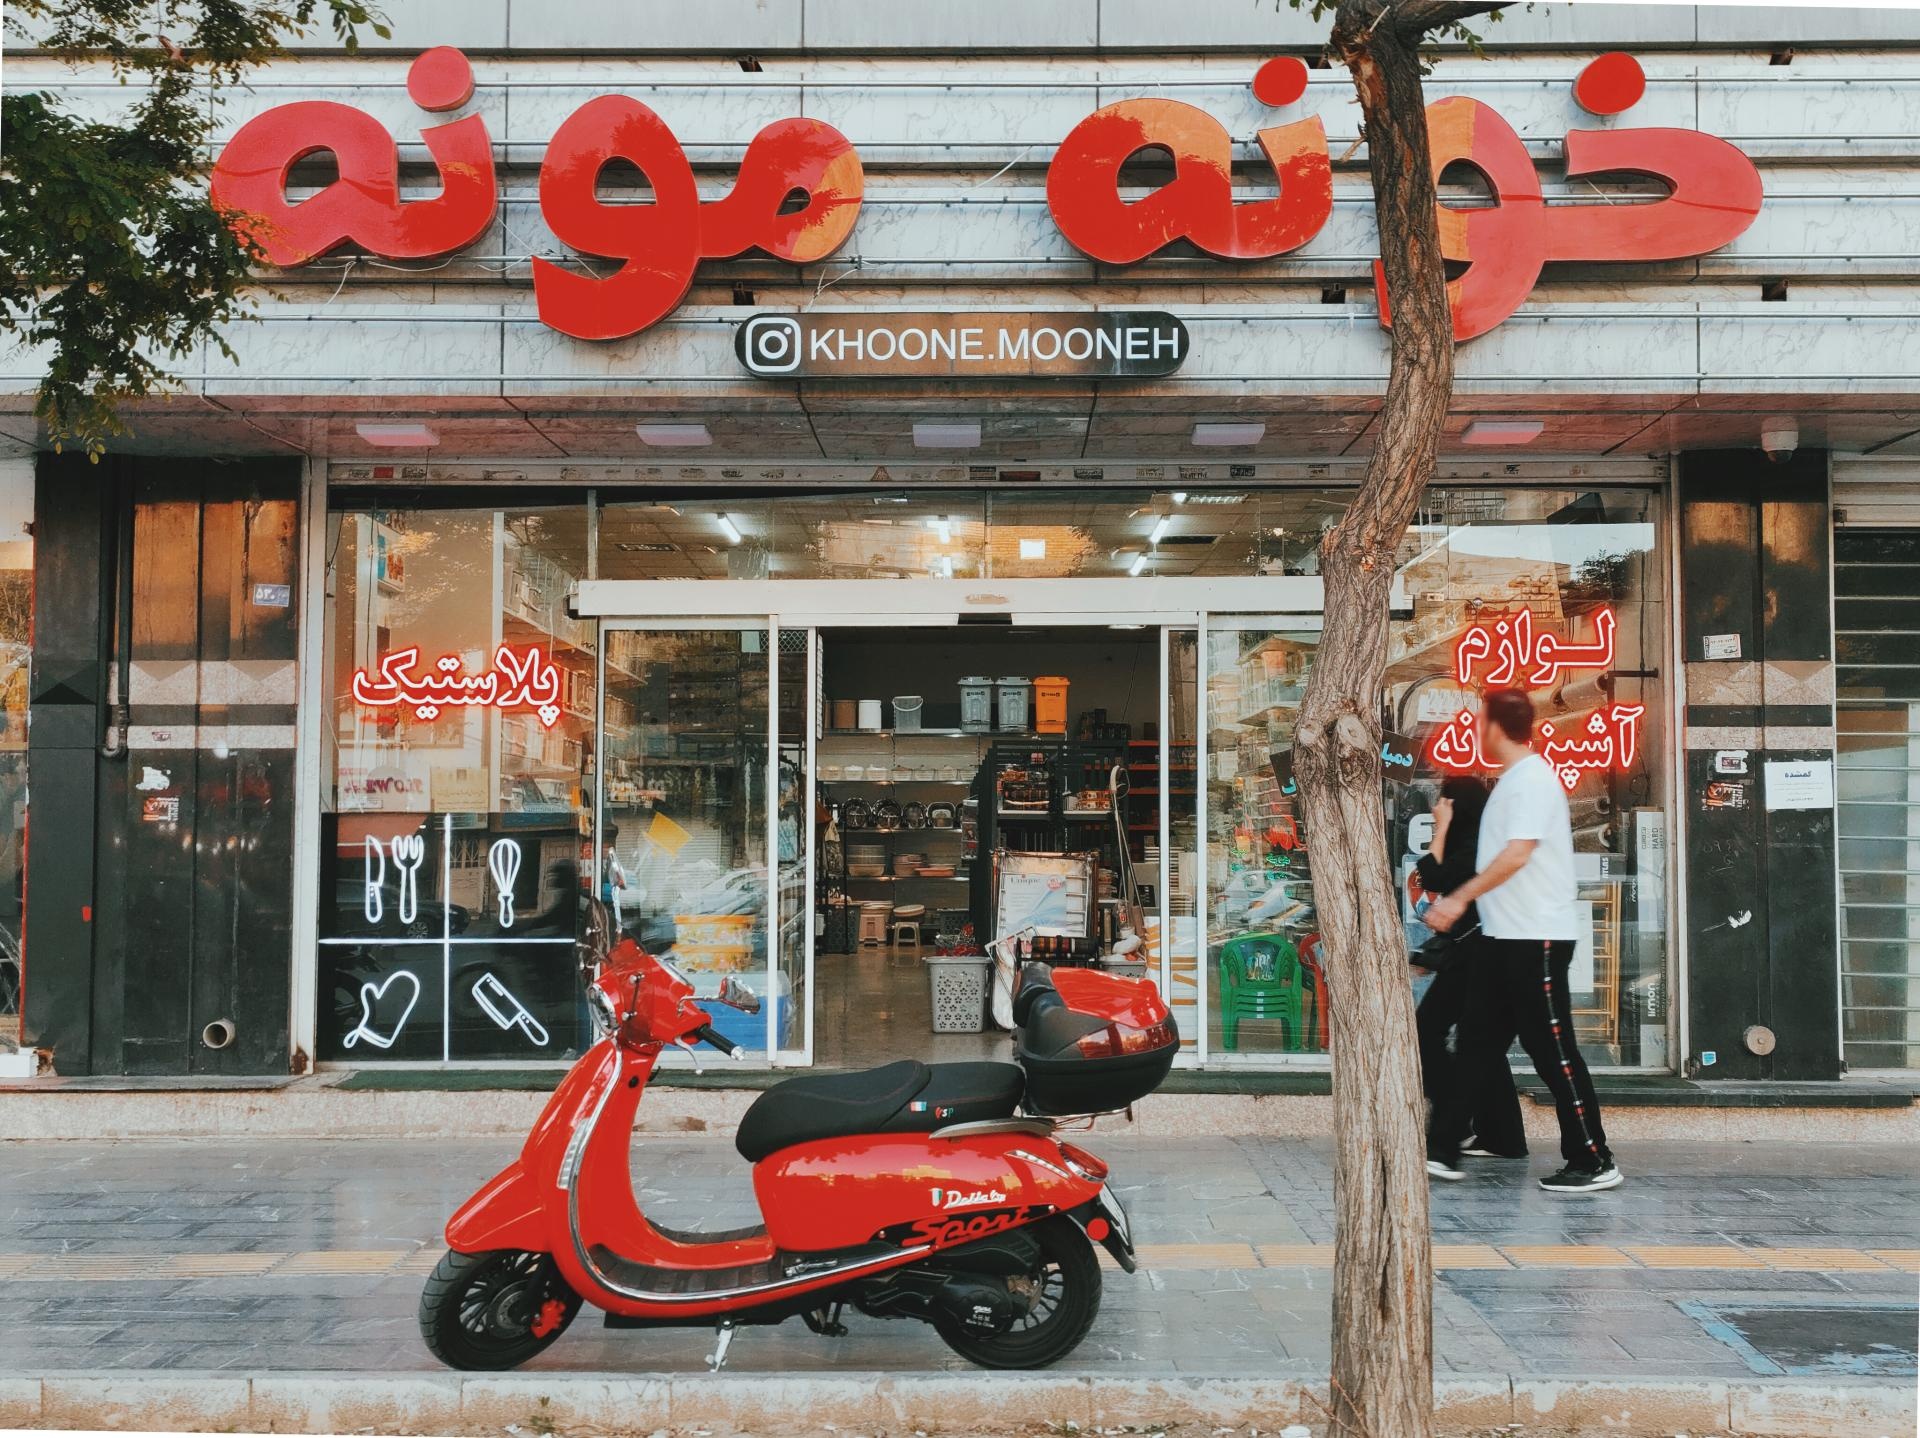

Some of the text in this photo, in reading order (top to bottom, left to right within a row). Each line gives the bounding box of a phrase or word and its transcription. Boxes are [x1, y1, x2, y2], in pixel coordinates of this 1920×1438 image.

[211, 46, 865, 341] مونه
[810, 327, 1180, 361] KHOONE.MOONEH
[1458, 608, 1616, 684] لوازم
[352, 647, 559, 727] پلاستیک
[1381, 742, 1414, 768] دمپا
[1432, 705, 1645, 790] آشپزنه
[1647, 982, 1656, 1017] limon
[902, 1205, 1031, 1249] Sport
